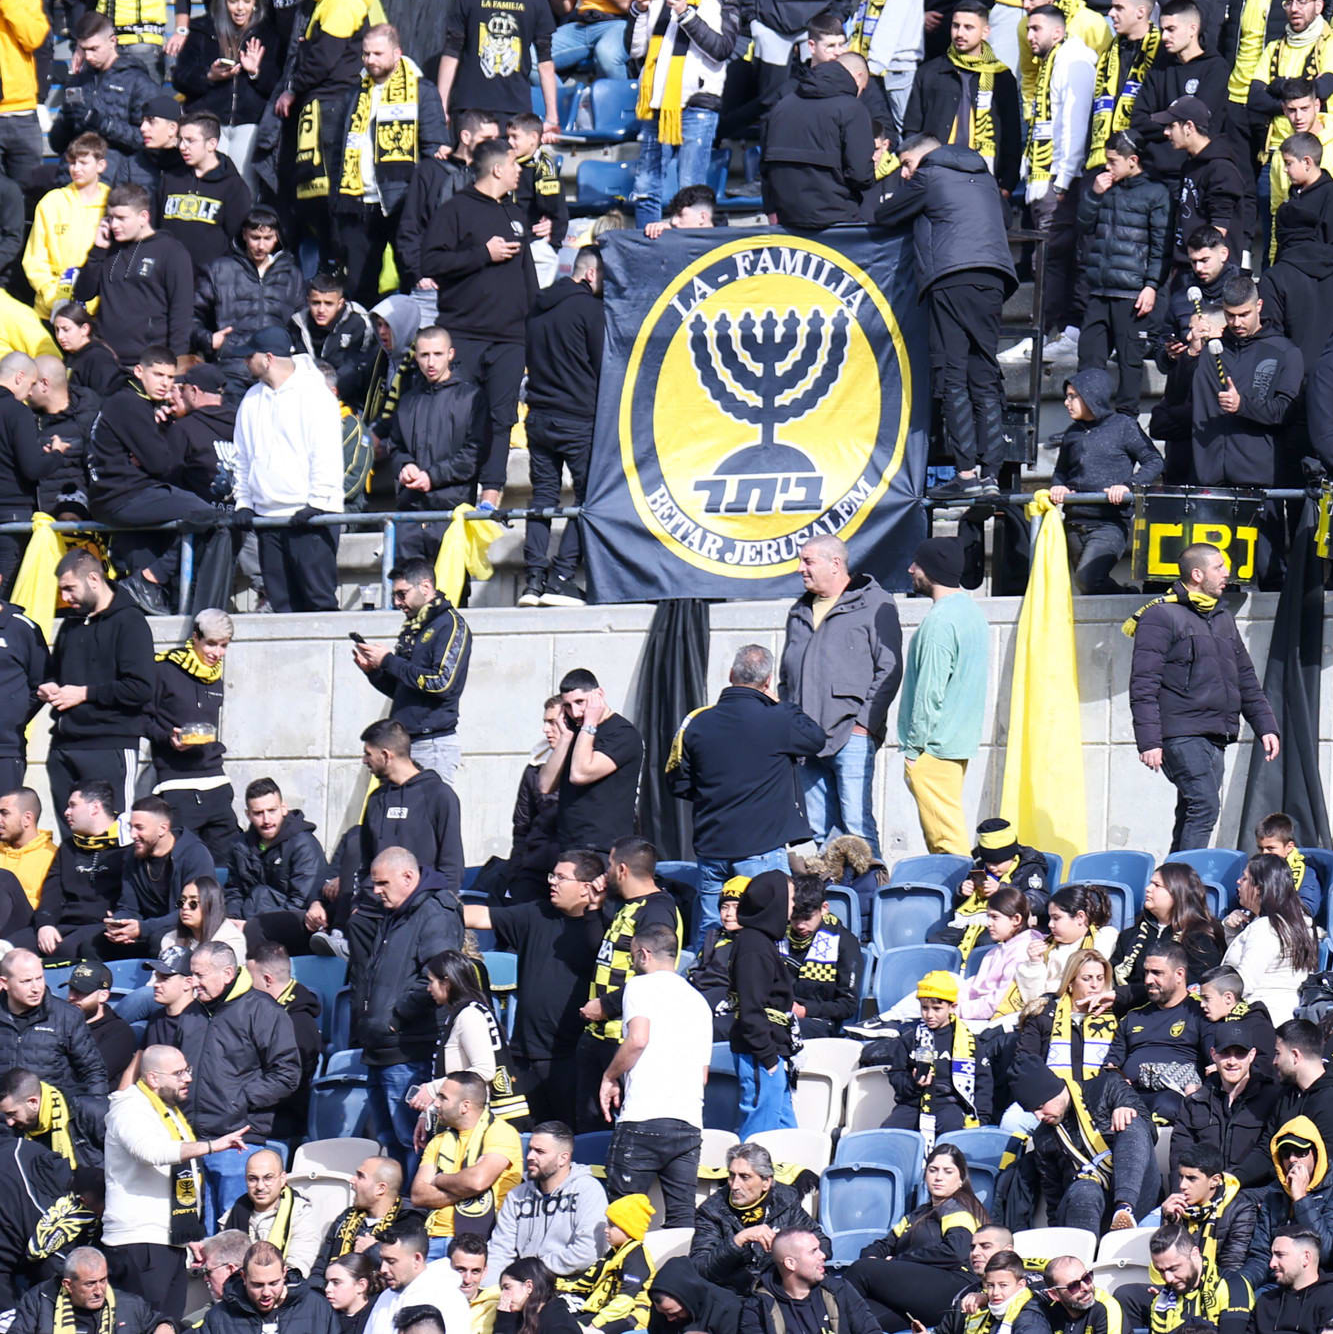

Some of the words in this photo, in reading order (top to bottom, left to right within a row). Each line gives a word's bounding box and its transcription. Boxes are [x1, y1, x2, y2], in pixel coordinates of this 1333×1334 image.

[732, 245, 873, 318] FAMILIA
[645, 483, 722, 563] BEITAR
[692, 474, 824, 517] ביתר
